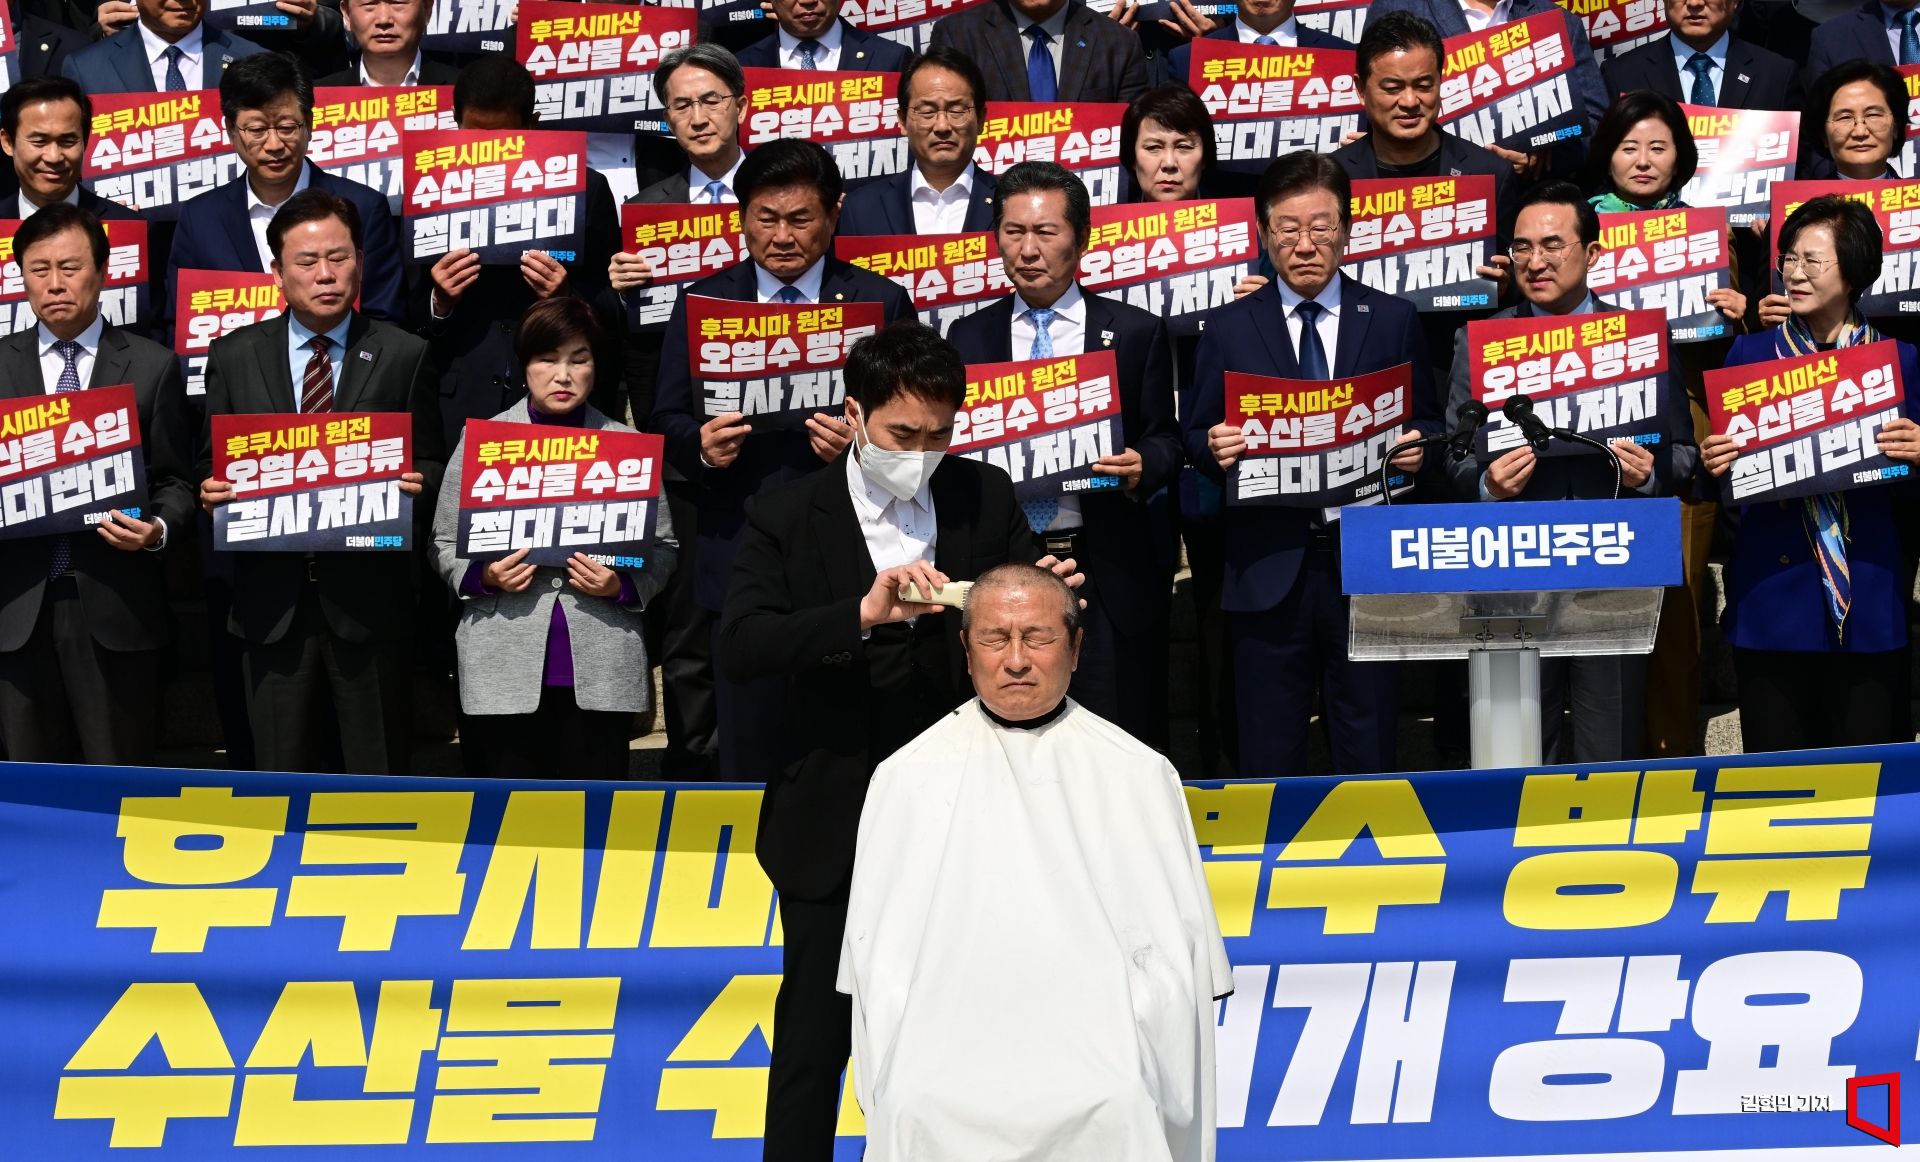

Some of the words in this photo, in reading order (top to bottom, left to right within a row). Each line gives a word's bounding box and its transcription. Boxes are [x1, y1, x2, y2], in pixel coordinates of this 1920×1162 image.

[237, 15, 289, 26] 더불어민주당
[530, 10, 642, 42] 후쿠시마산
[1489, 21, 1531, 58] 원전
[525, 37, 623, 76] 수산물
[1202, 53, 1315, 82] 후쿠시마산
[1439, 65, 1502, 118] 염수
[1503, 33, 1565, 87] 방류
[91, 94, 201, 137] 후쿠시마산
[394, 88, 438, 116] 원전
[534, 78, 604, 122] 절대
[608, 73, 667, 115] 반
[751, 81, 836, 111] 후쿠시마
[840, 76, 883, 102] 원전
[1199, 80, 1295, 115] 수산물
[1496, 73, 1573, 139] 저지
[308, 120, 399, 163] 오염수
[748, 104, 844, 144] 오염수
[1060, 125, 1121, 164] 수입
[1531, 124, 1582, 148] 더불어민주당
[90, 123, 185, 171] 수산물
[414, 135, 525, 174] 후쿠시마산
[832, 136, 909, 180] 저지
[94, 165, 172, 210] 절대
[412, 164, 506, 209] 수산물
[511, 153, 578, 193] 수입
[1411, 180, 1456, 208] 원전
[413, 207, 489, 259] 절대
[494, 194, 577, 246] 반대
[635, 213, 723, 246] 후쿠시마
[1174, 202, 1218, 232] 원전
[1343, 213, 1416, 257] 염수
[1420, 198, 1488, 241] 방류
[1643, 211, 1687, 241] 원전
[636, 237, 734, 278] 오염수
[943, 235, 987, 264] 원전
[1079, 237, 1178, 287] 오염수
[1184, 221, 1250, 265] 방류
[1404, 241, 1485, 292] 저지
[1587, 246, 1649, 289] 염수
[1654, 229, 1720, 273] 방류
[190, 284, 280, 314] 후쿠시마
[1433, 293, 1489, 307] 더불어민주당
[701, 313, 790, 341] 후쿠시마
[797, 306, 843, 333] 원전
[1483, 328, 1575, 366] 후쿠시마
[1581, 314, 1627, 346] 원전
[700, 337, 800, 373] 오염수
[1482, 351, 1586, 403] 오염수
[1591, 332, 1660, 380] 방류
[704, 376, 784, 417] 결사
[964, 372, 1027, 408] 쿠시마
[1031, 358, 1078, 392] 원전
[1043, 375, 1112, 424] 방류
[1239, 383, 1354, 416] 후쿠시마산
[1576, 376, 1657, 434] 저지
[1721, 356, 1839, 414] 후쿠시마산
[1240, 411, 1336, 450] 수산물
[1341, 385, 1404, 436] 수입
[1723, 388, 1826, 448] 수산물
[1830, 363, 1896, 415] 수입
[62, 407, 131, 457] 수입
[226, 424, 320, 459] 후쿠시마
[325, 416, 371, 445] 원전
[477, 435, 600, 466] 후쿠시마산
[1031, 418, 1113, 479] 저지
[50, 450, 136, 514] 반대
[225, 448, 329, 494] 오염수
[334, 436, 404, 478] 방류
[470, 462, 578, 502] 수산물
[581, 457, 654, 494] 수입
[1062, 476, 1120, 492] 더불어민주당
[1237, 454, 1320, 500] 절대
[1730, 436, 1816, 500] 절대
[1852, 464, 1909, 484] 더불어민주당
[226, 492, 313, 543] 결사
[316, 480, 401, 531] 저지
[467, 507, 556, 553] 절대
[559, 500, 648, 547] 반대
[345, 535, 404, 548] 더불어민주당
[1391, 521, 1635, 571] 더불어민주당
[96, 786, 784, 953] 후쿠시마
[1503, 761, 1883, 931] 방류
[53, 976, 622, 1148] 수산물
[1488, 949, 1864, 1123] 강요
